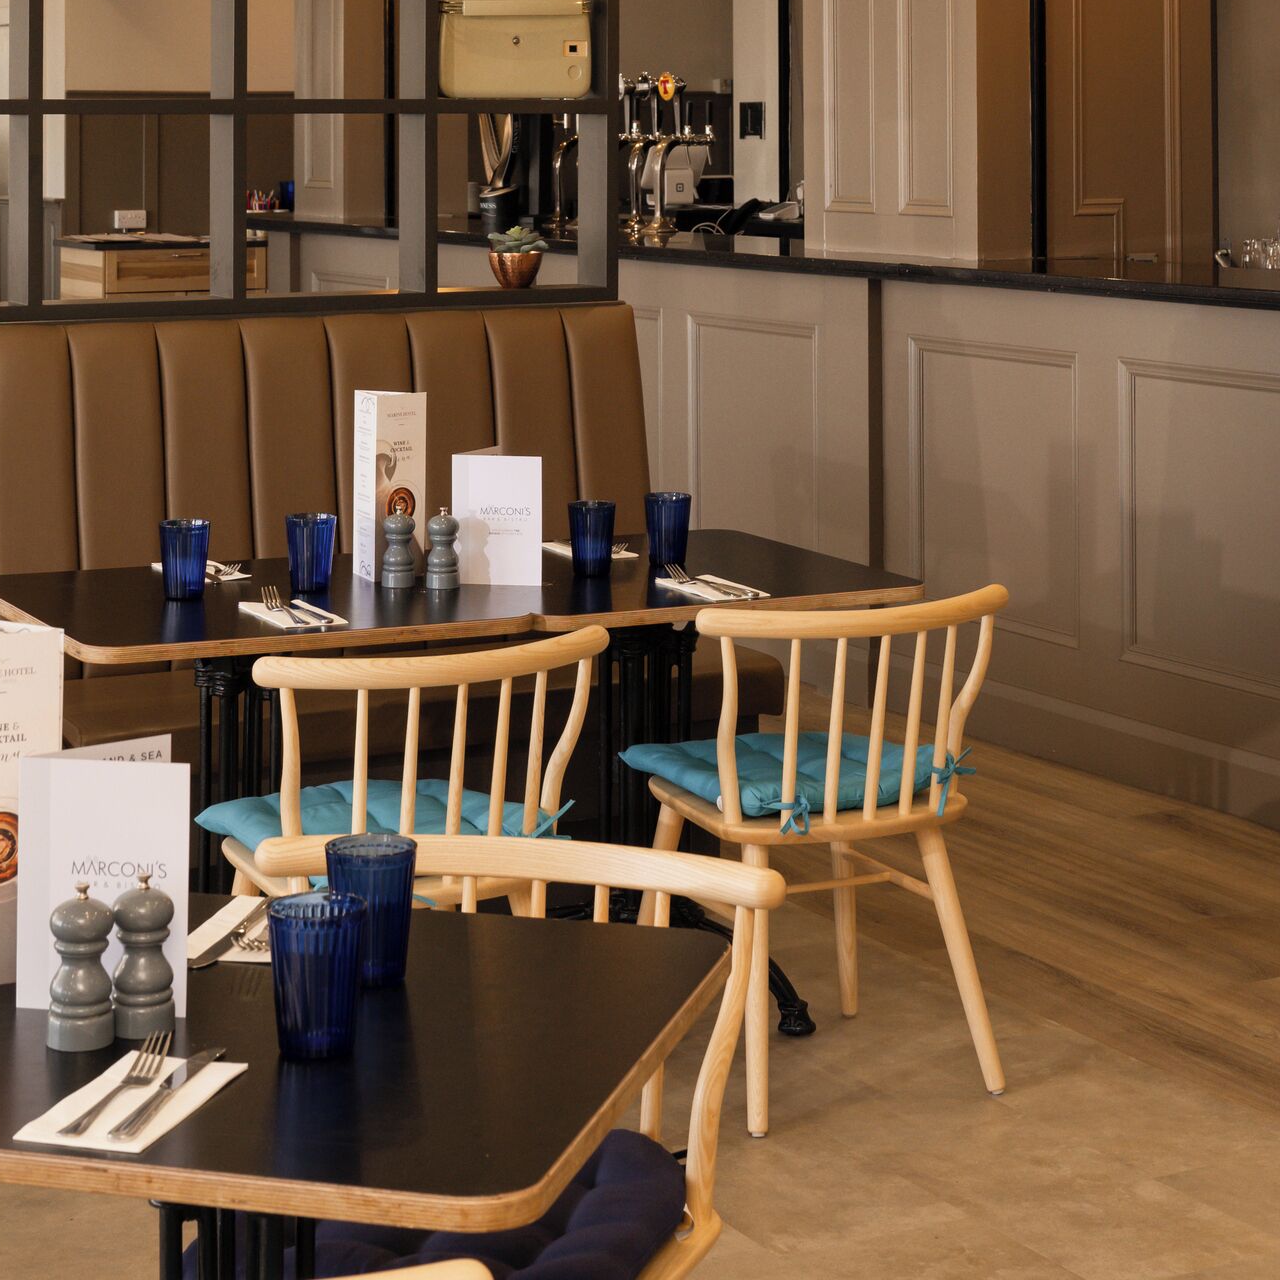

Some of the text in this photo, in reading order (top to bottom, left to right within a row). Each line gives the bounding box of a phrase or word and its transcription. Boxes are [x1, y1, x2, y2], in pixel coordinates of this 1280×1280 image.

[660, 79, 670, 96] T
[480, 506, 531, 516] MARCONI'S
[4, 666, 37, 677] HOTEL
[12, 721, 21, 731] &
[141, 750, 162, 761] SEA
[71, 859, 168, 880] MARCONI'S
